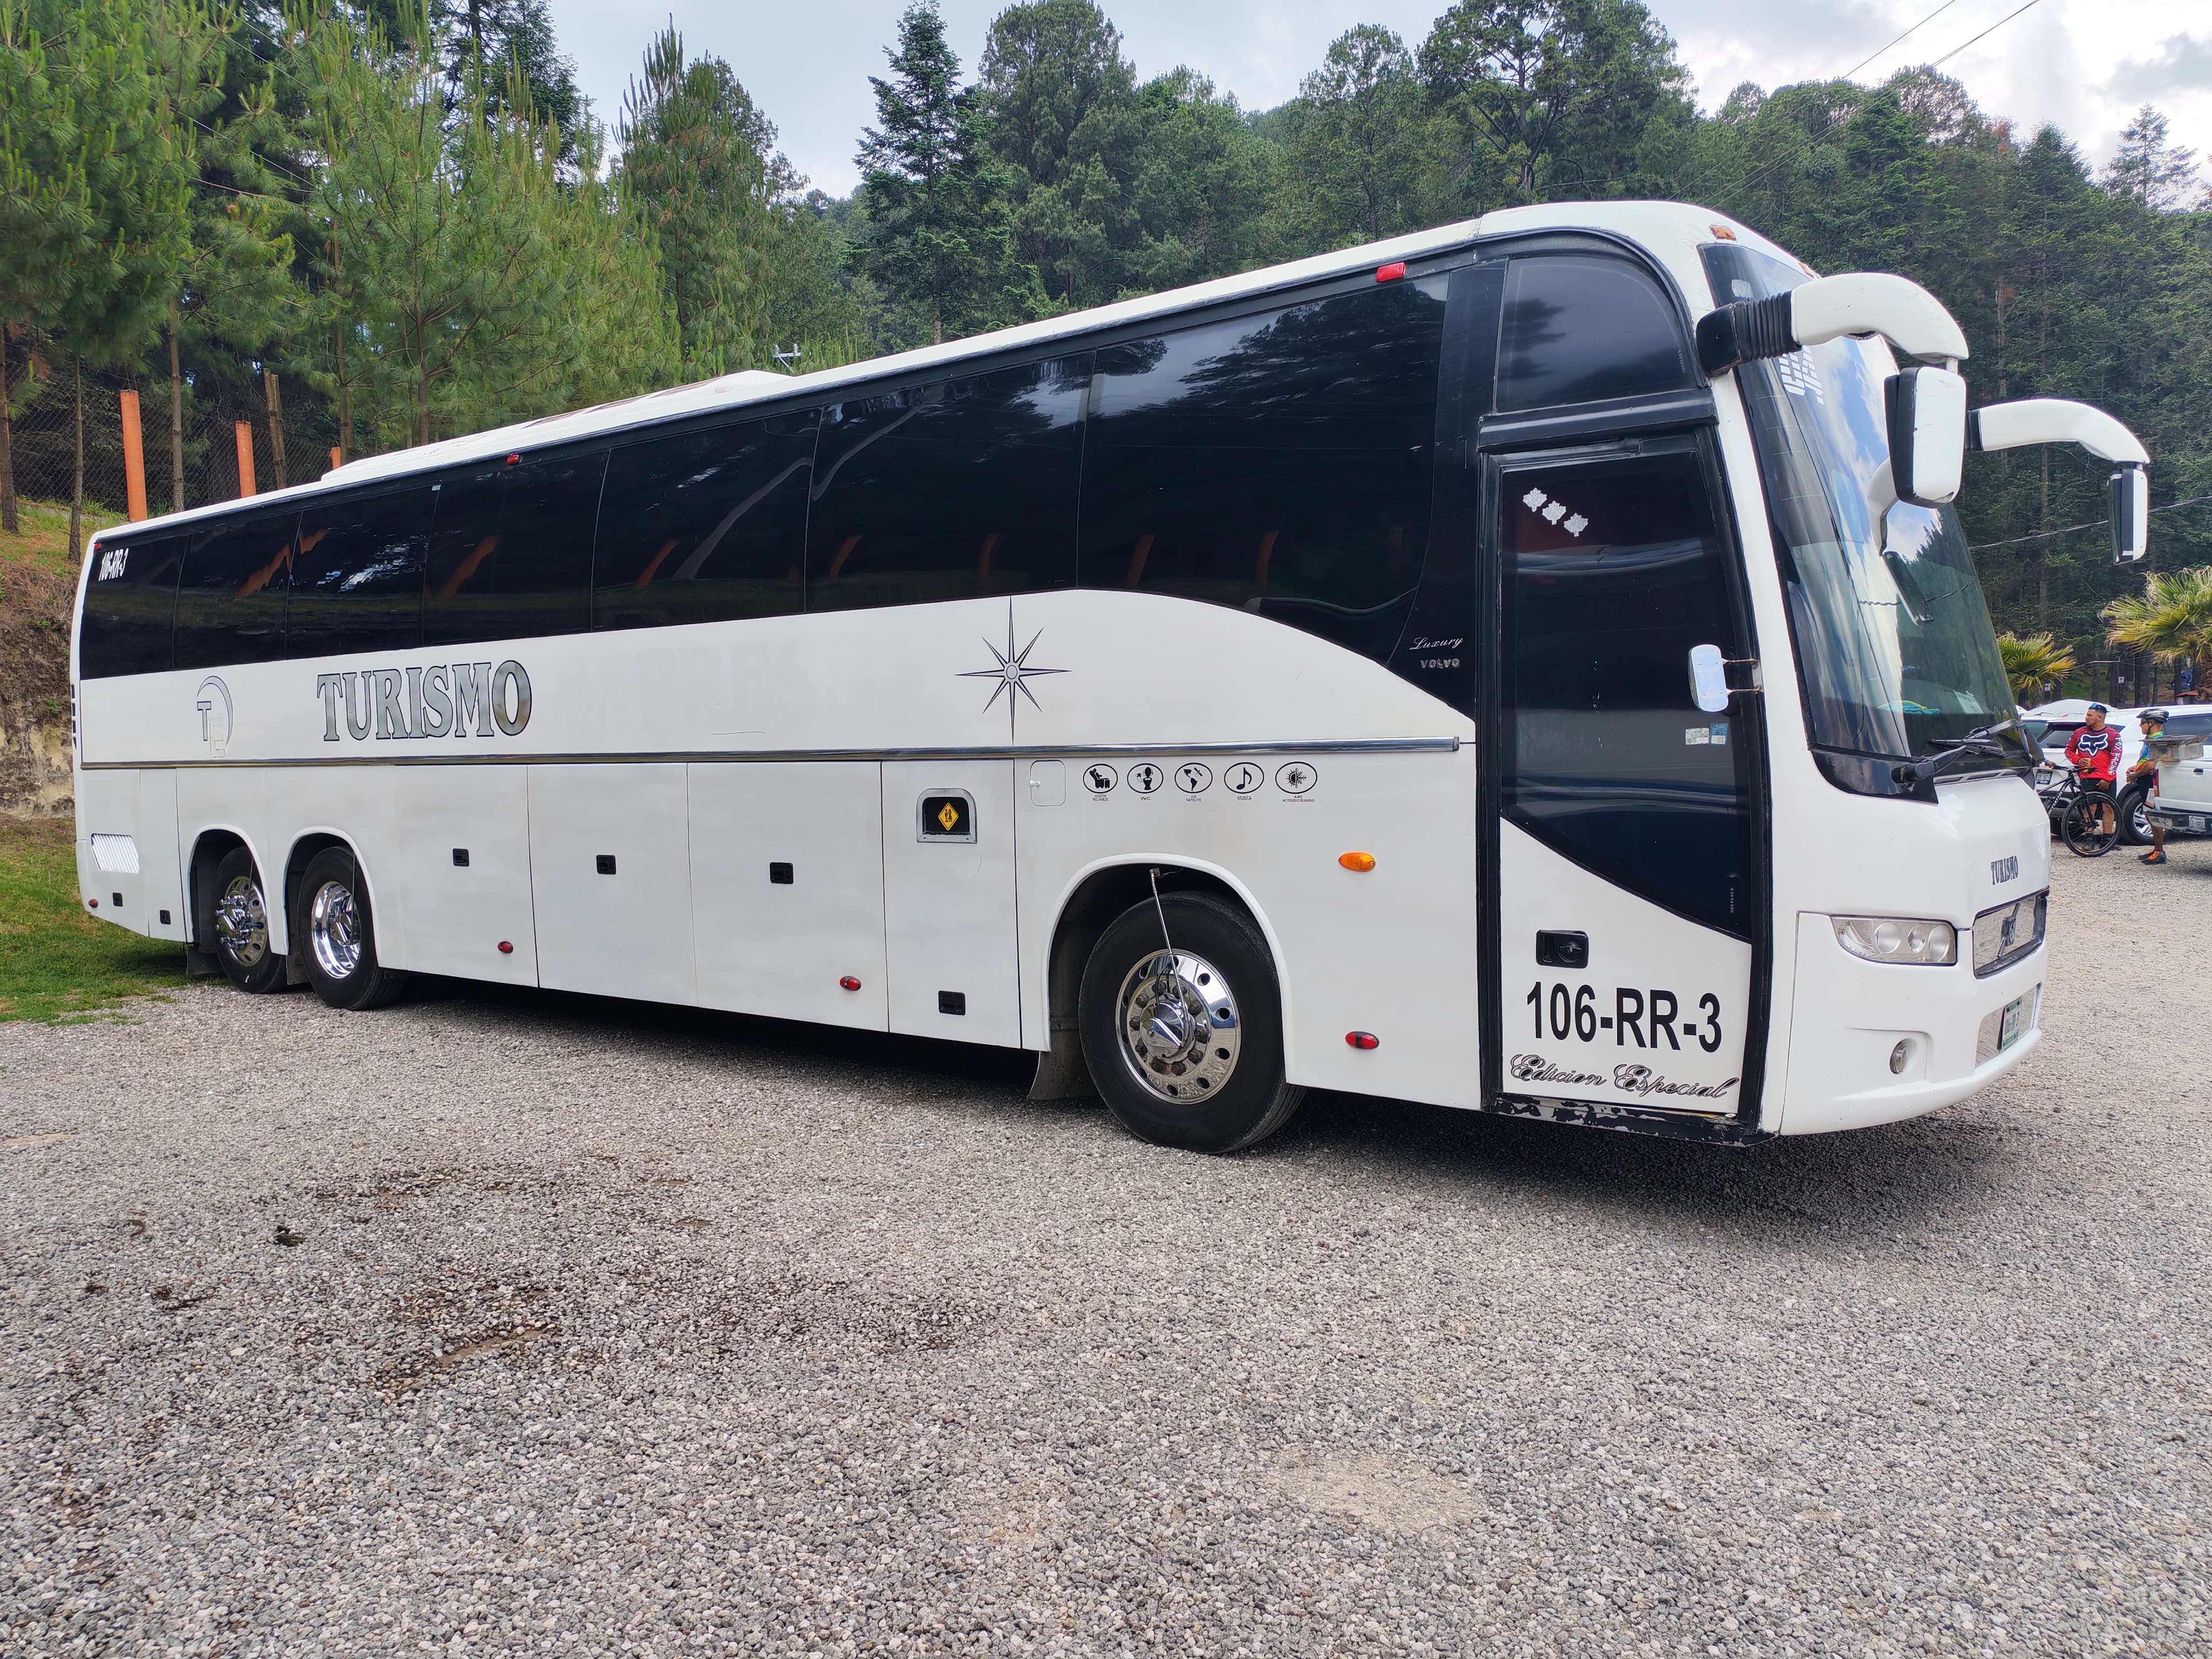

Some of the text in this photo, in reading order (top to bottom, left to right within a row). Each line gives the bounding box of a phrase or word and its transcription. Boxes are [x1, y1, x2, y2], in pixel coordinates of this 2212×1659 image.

[98, 548, 129, 582] 106-RR-3
[1409, 637, 1464, 650] Luxury
[1420, 658, 1460, 669] VOLVO
[316, 659, 532, 741] TURISMO
[2108, 737, 2122, 775] FOX RACING
[1991, 855, 2019, 885] TURISMO
[1527, 981, 1722, 1053] 106-RR-3
[1510, 1054, 1739, 1099] Edicion Especial
